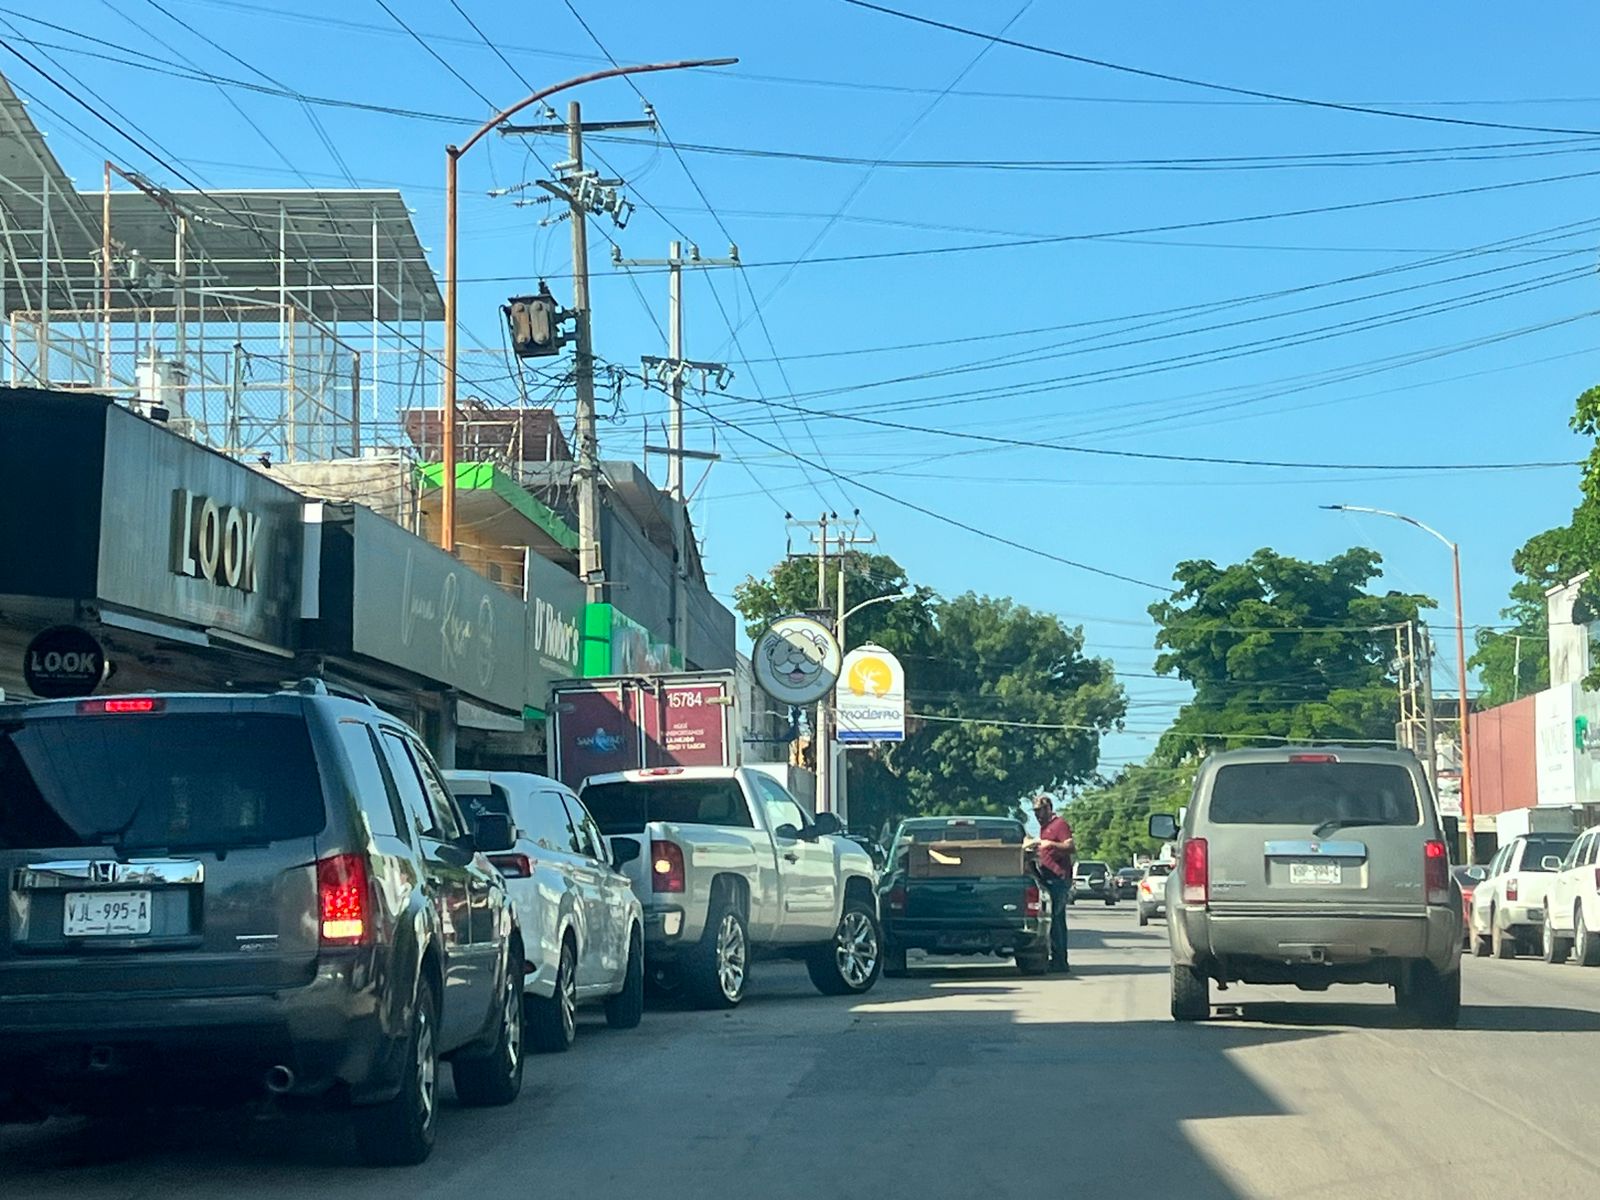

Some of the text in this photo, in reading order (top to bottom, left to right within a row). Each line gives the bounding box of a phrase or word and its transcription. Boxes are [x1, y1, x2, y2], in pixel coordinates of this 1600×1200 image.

[174, 489, 261, 593] LOOK
[31, 650, 96, 673] LOOK
[666, 692, 703, 708] 15784
[68, 902, 148, 922] VJL-995-A
